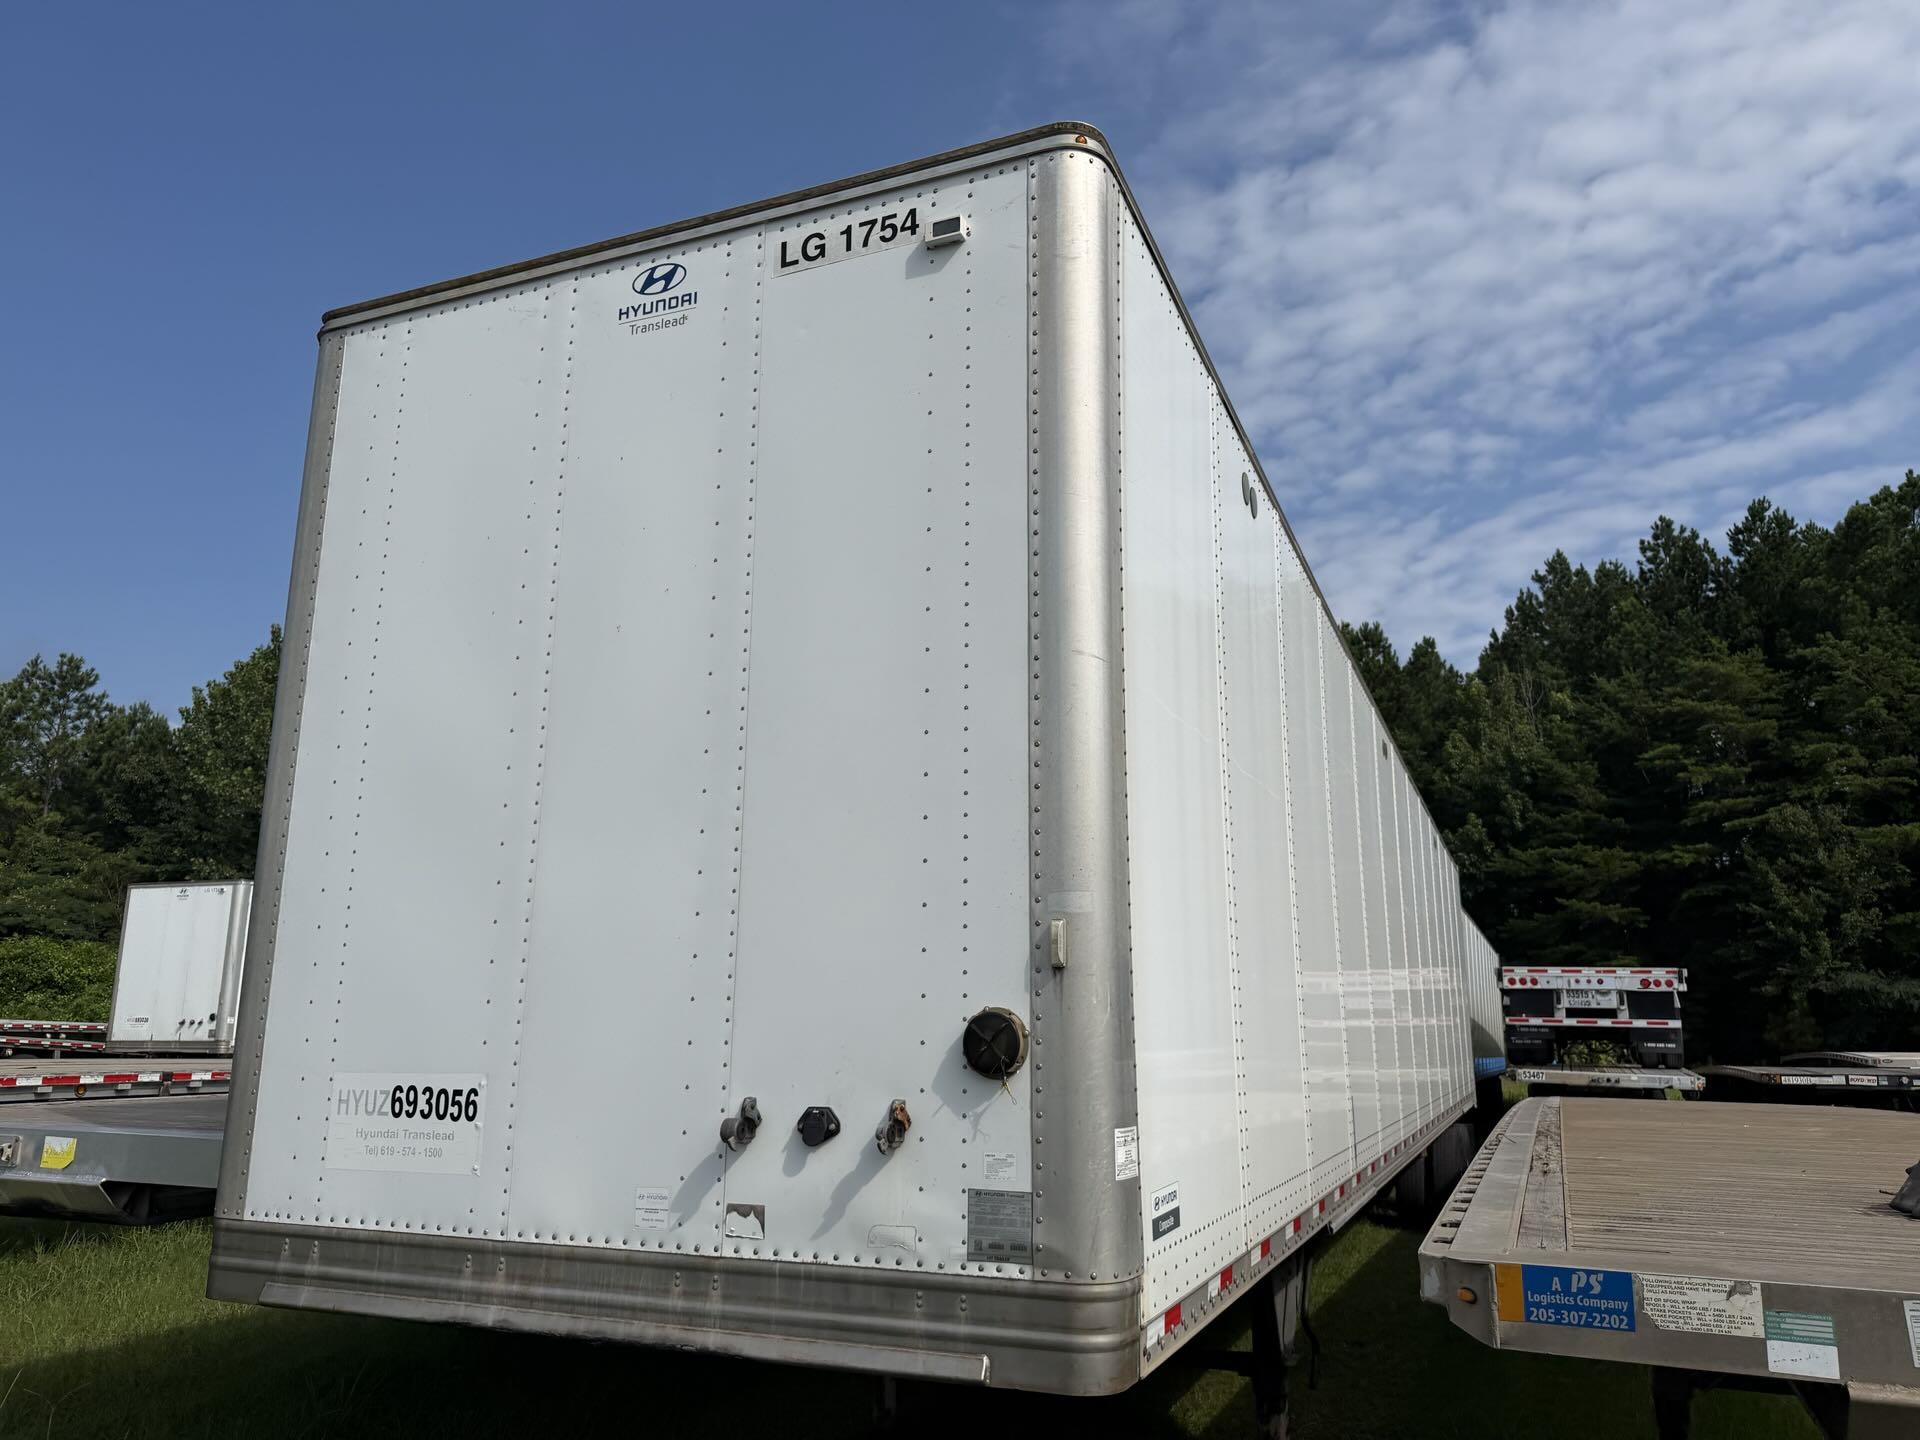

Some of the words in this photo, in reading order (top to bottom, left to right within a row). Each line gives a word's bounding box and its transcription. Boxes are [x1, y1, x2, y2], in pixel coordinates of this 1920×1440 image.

[780, 233, 826, 269] LG
[840, 207, 920, 252] 1754
[619, 292, 697, 320] HYUNDAI
[356, 1128, 400, 1141] Hyundai
[402, 1129, 455, 1141] Translead
[364, 1145, 379, 1156] Tel)
[381, 1145, 395, 1156] 619
[401, 1146, 416, 1157] 574
[424, 1147, 443, 1158] 1500
[1552, 1277, 1562, 1291] A
[1571, 1271, 1604, 1295] PS
[1527, 1291, 1574, 1305] Logistics
[1576, 1295, 1628, 1313] Company
[1529, 1307, 1629, 1329] 205-307-2202
